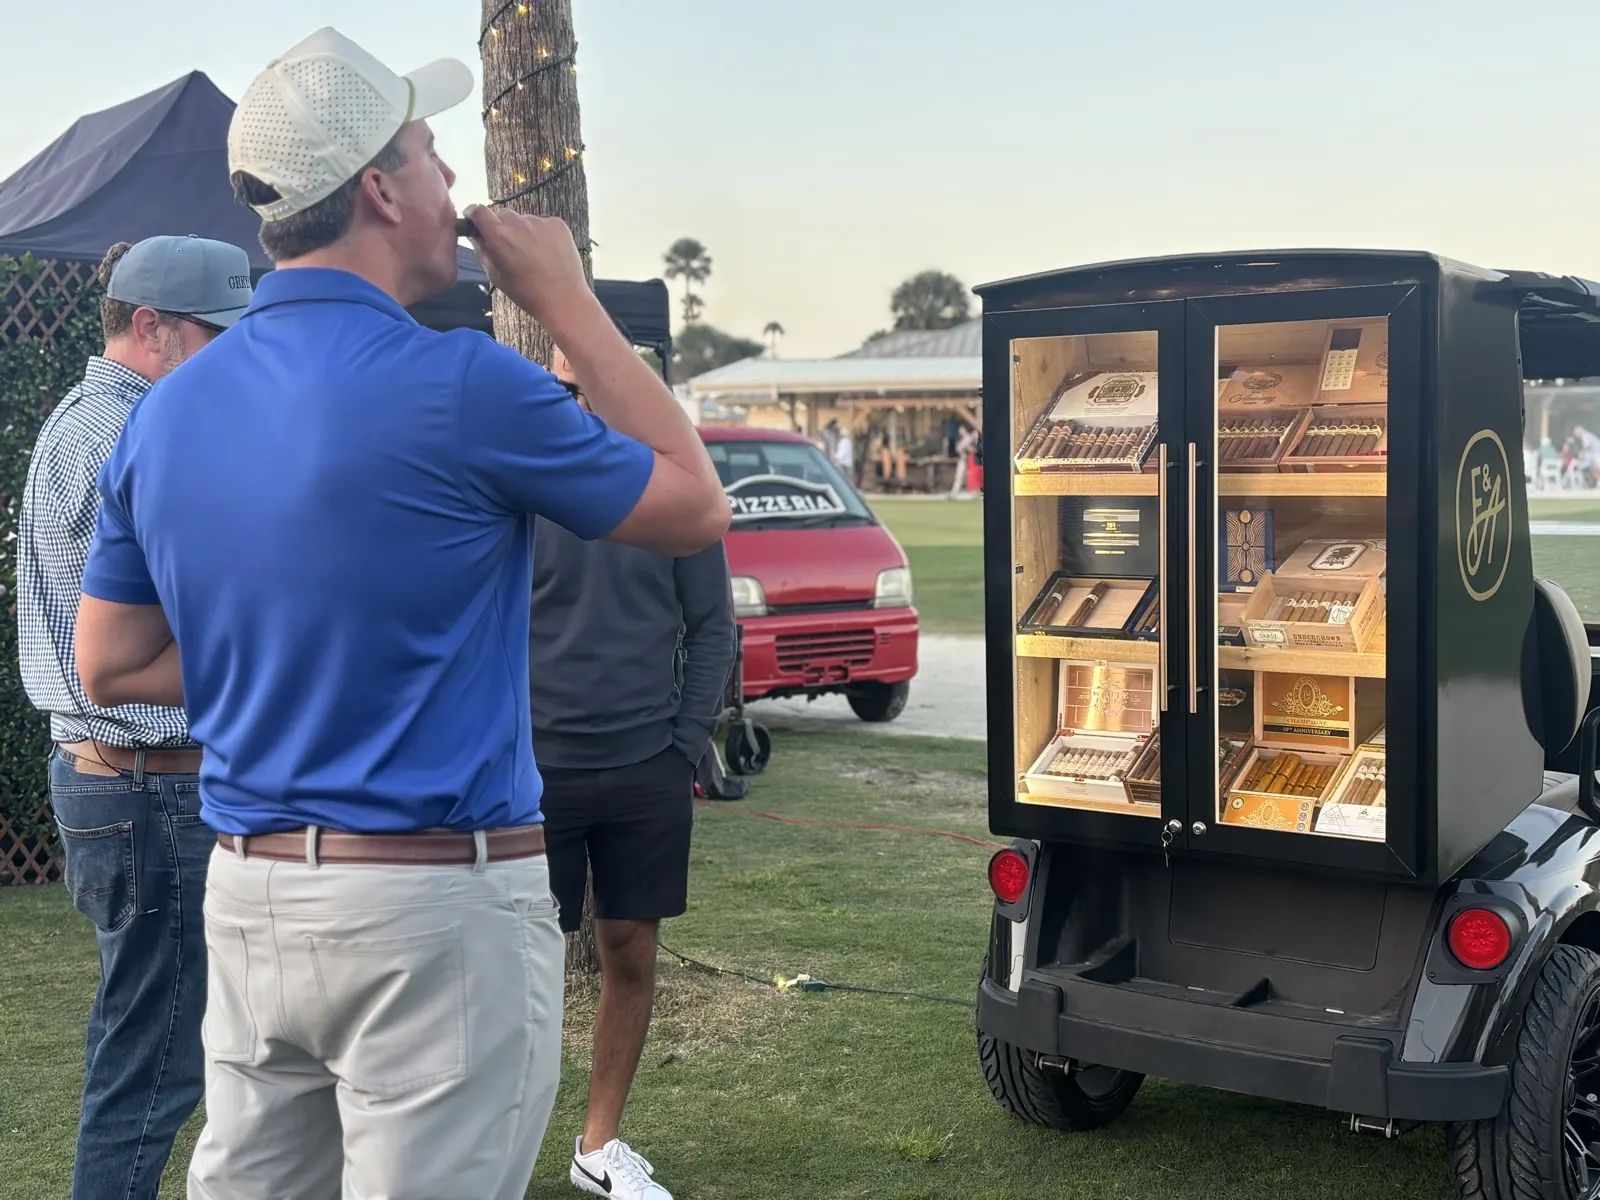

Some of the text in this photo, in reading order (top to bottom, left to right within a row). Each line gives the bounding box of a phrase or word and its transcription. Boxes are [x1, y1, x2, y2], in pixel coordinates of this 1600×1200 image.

[727, 495, 834, 513] PIZZERIA
[1286, 718, 1328, 726] CHAMPAGNE
[1293, 728, 1332, 736] ANNIVERSARY
